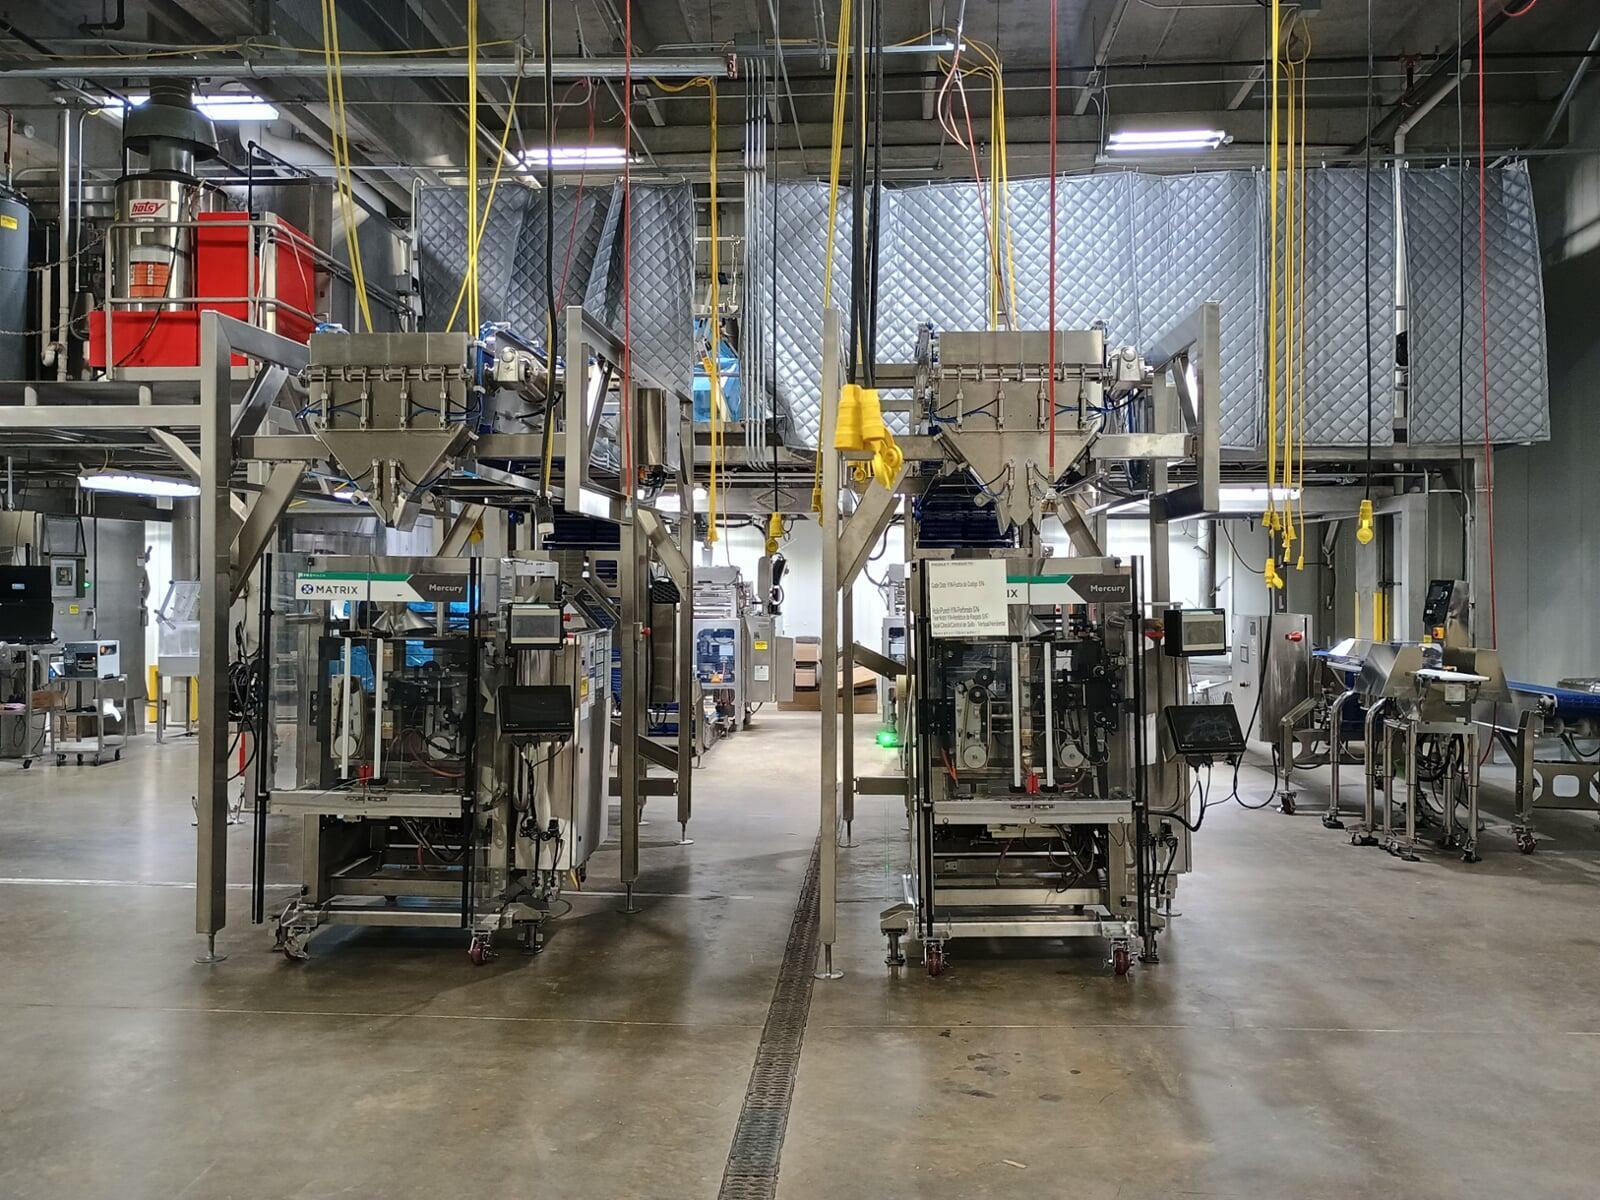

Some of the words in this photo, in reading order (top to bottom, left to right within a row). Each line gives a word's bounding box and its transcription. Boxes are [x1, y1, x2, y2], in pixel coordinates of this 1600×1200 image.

[316, 585, 358, 594] MATRIX
[429, 584, 463, 593] Mercury
[1090, 585, 1126, 593] Mercury
